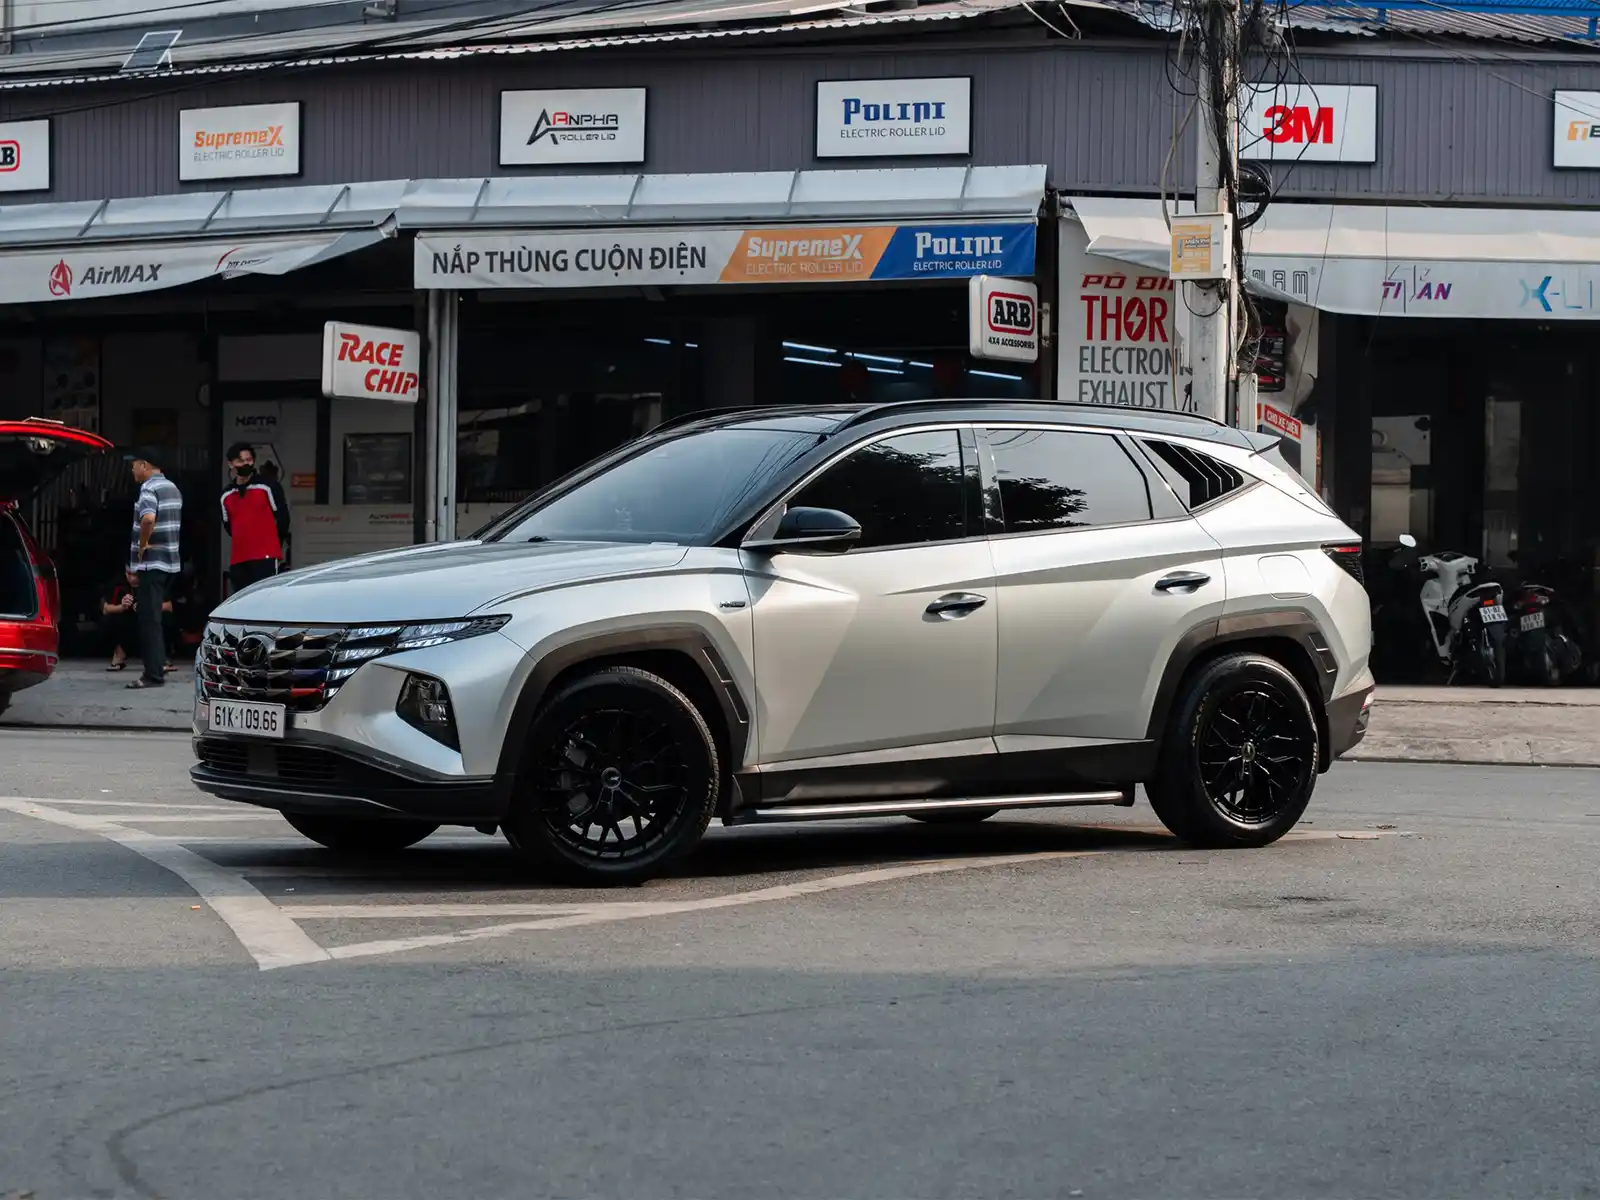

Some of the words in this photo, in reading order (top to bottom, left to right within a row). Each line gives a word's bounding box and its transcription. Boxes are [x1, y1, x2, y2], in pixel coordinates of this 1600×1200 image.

[559, 133, 600, 141] ROLLER
[601, 133, 616, 141] LID
[841, 128, 887, 138] ELECTRIC
[889, 127, 927, 137] ROLLER
[929, 126, 946, 136] LID
[1263, 105, 1334, 144] 3M
[193, 150, 233, 162] ELECTRIC
[235, 148, 269, 160] ROLLER
[270, 147, 285, 157] LID
[432, 244, 480, 274] NẮP
[484, 246, 568, 274] THÙNG
[574, 244, 643, 278] CUỘN
[649, 241, 706, 276] ĐIỆN
[745, 262, 797, 276] ELECTRIC
[800, 261, 843, 274] ROLLER
[846, 260, 864, 273] LID
[913, 261, 954, 273] ELECTRIC
[955, 260, 987, 271] ROLLER
[988, 259, 1002, 270] LID
[79, 263, 163, 285] AirMAX
[992, 299, 1031, 328] ARB
[1080, 295, 1169, 343] THOR
[337, 332, 404, 367] RACE
[1001, 338, 1035, 350] ACCESSORIES
[364, 369, 418, 396] CHIP
[1078, 379, 1169, 409] EXHAUST
[214, 706, 278, 732] 61K-109.66
